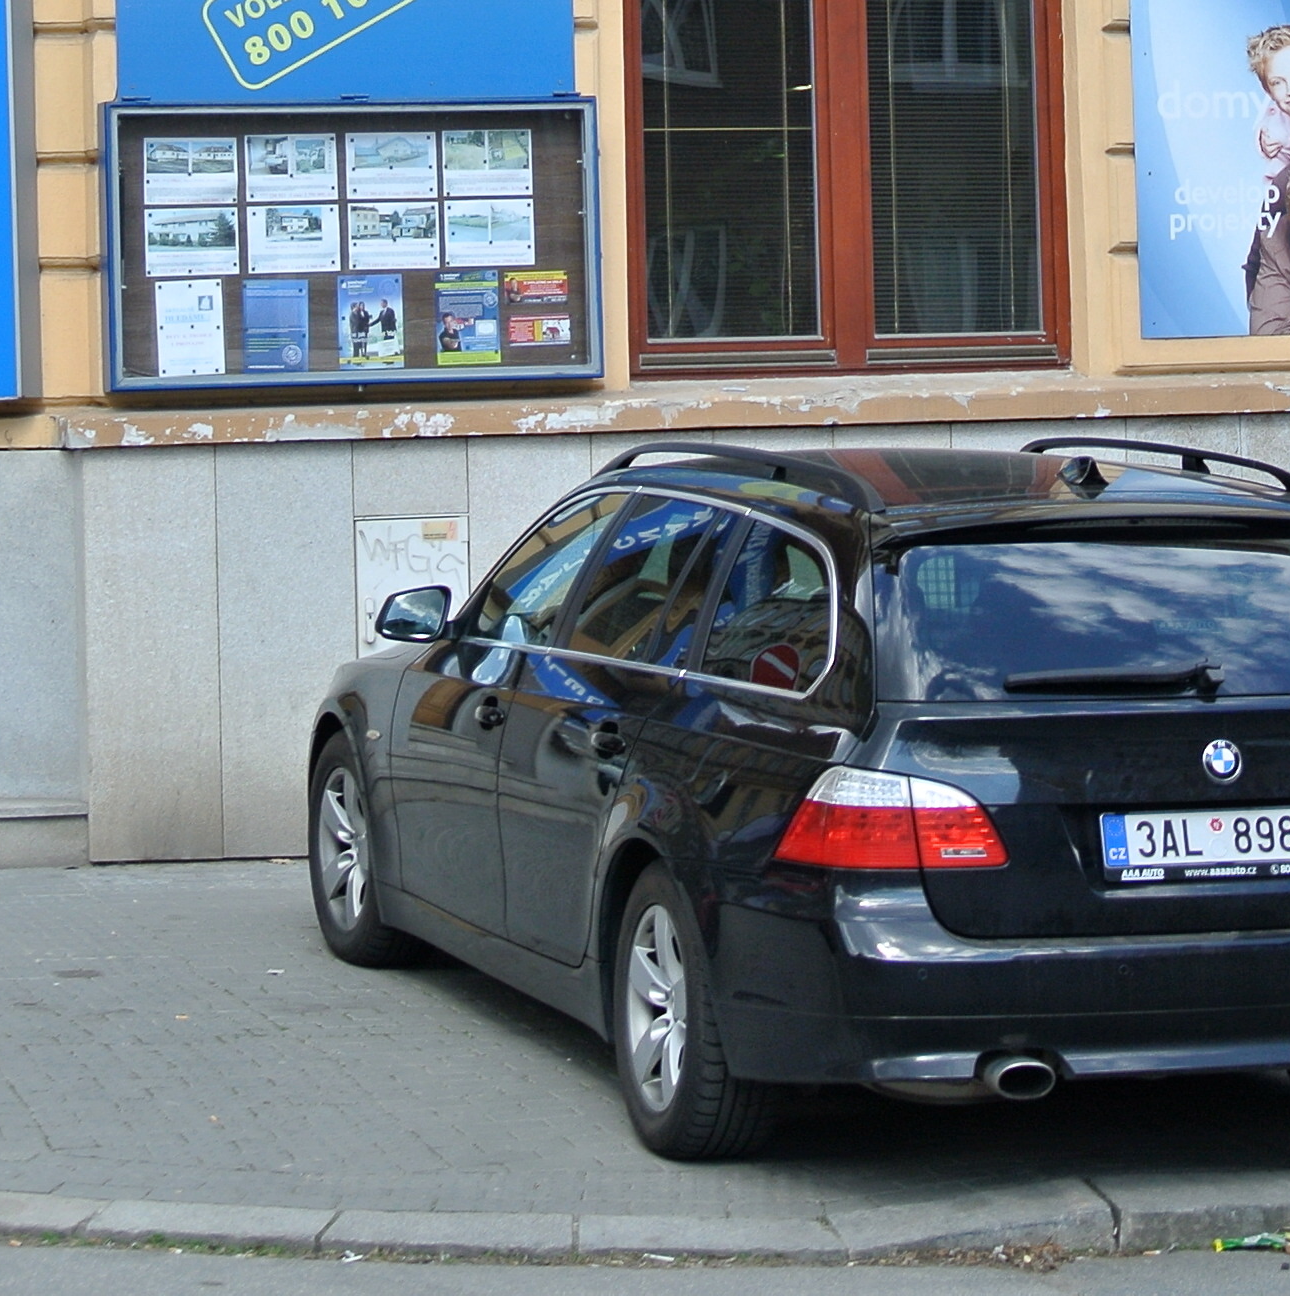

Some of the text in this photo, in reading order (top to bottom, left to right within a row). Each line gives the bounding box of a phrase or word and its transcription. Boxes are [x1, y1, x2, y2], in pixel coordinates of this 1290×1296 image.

[242, 10, 316, 66] 800
[1174, 179, 1281, 211] develop
[1169, 209, 1282, 239] projekty
[1109, 846, 1128, 860] CZ
[1135, 817, 1204, 858] 3AL
[1121, 868, 1142, 879] AAA
[1142, 867, 1165, 878] AUTO
